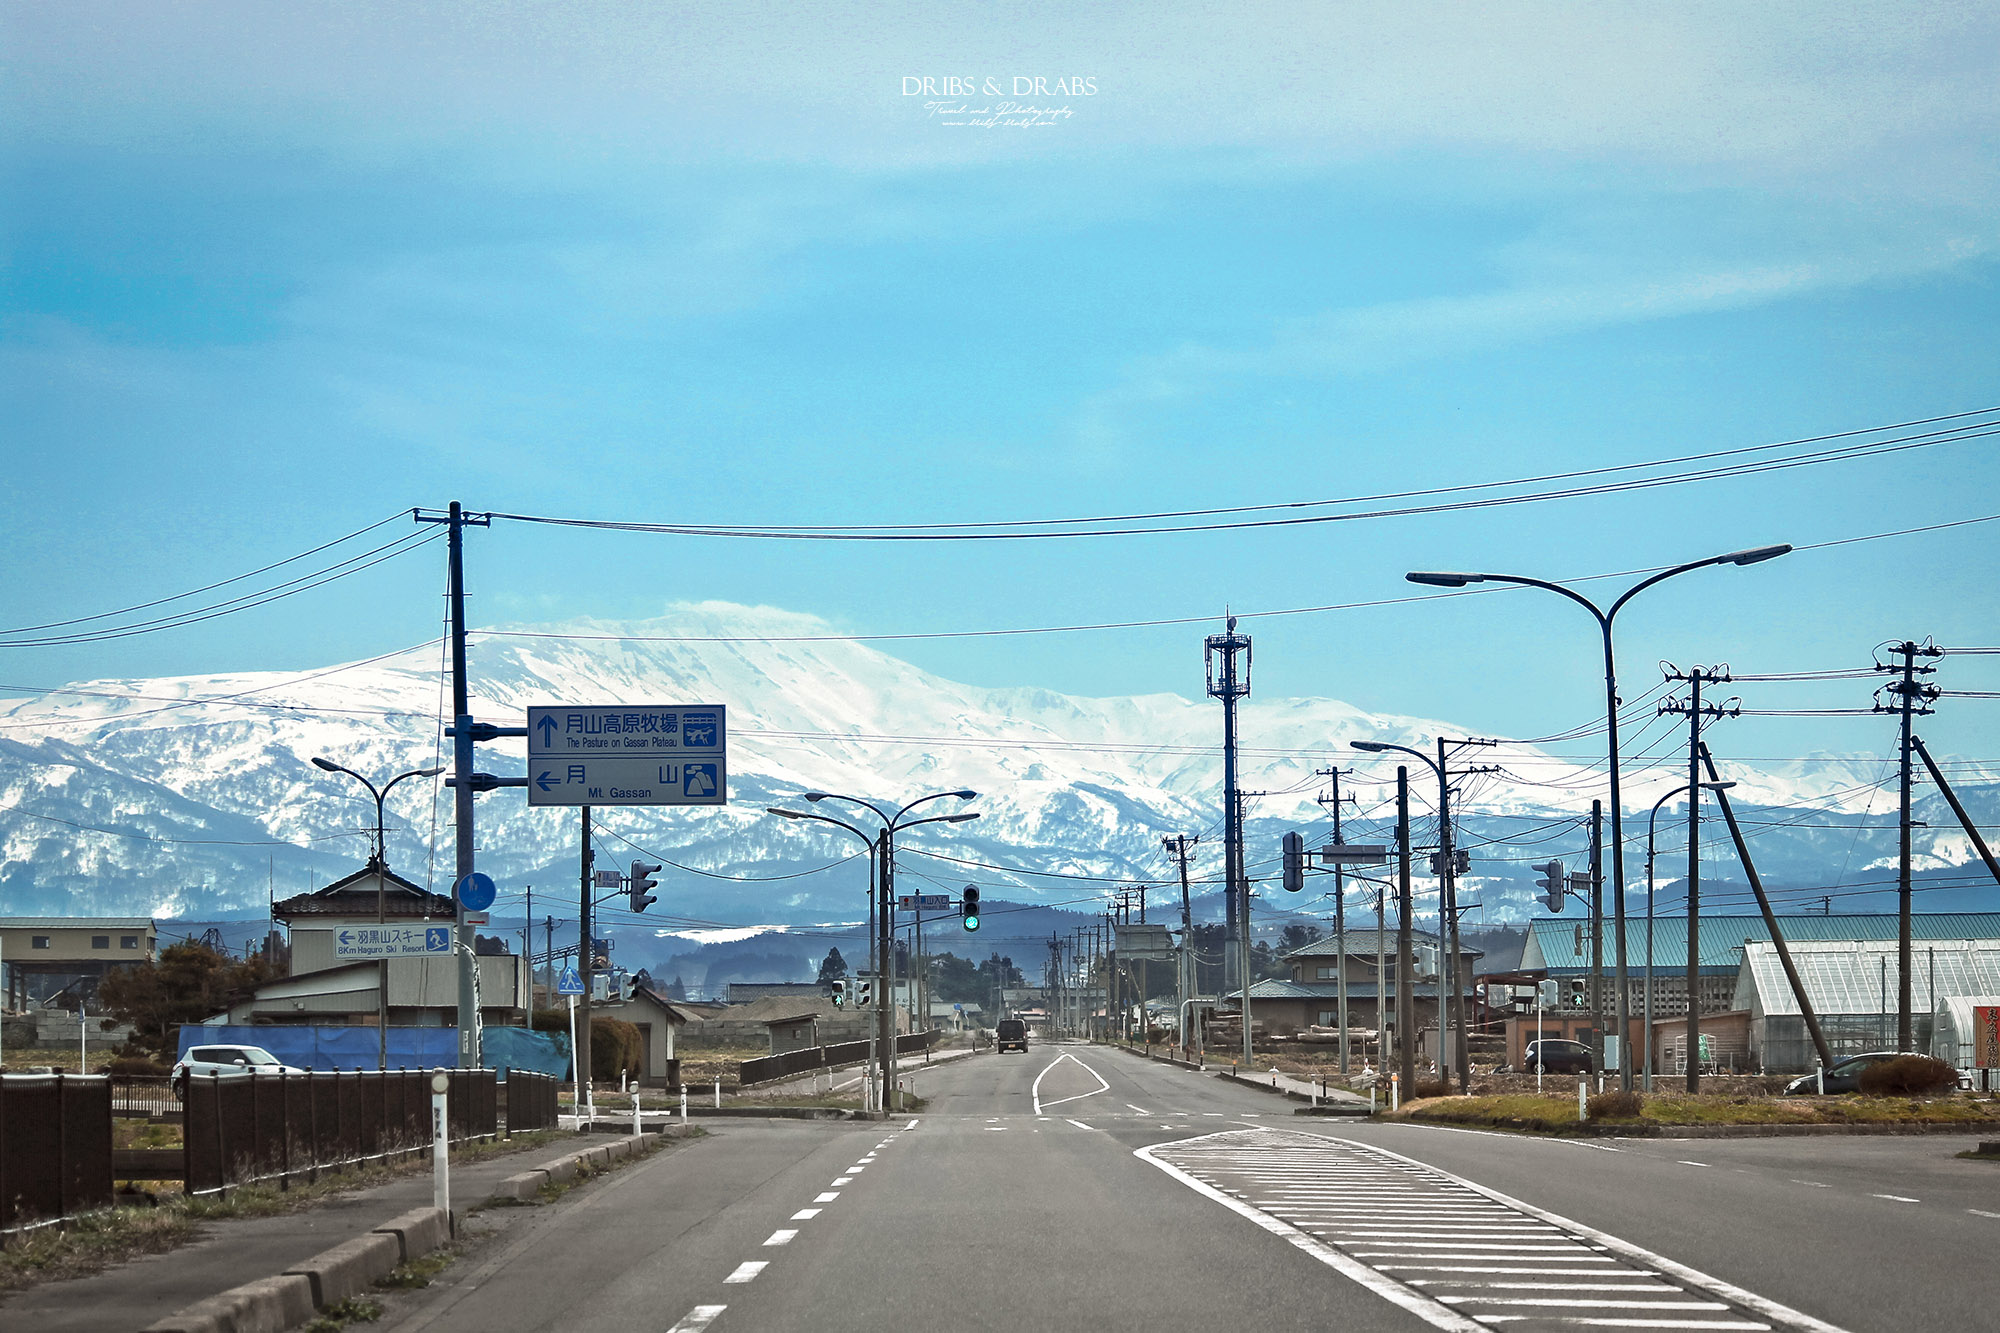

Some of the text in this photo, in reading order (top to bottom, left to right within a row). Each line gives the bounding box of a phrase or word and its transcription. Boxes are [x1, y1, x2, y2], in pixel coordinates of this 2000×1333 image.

[565, 713, 678, 735] 月山高原牧場
[566, 736, 678, 748] The Pasture on Gassan Plateau
[588, 787, 652, 799] Mt. Gassan
[357, 929, 425, 944] 羽黒山スキー
[337, 945, 425, 955] 8Km Haguro Ski Resort
